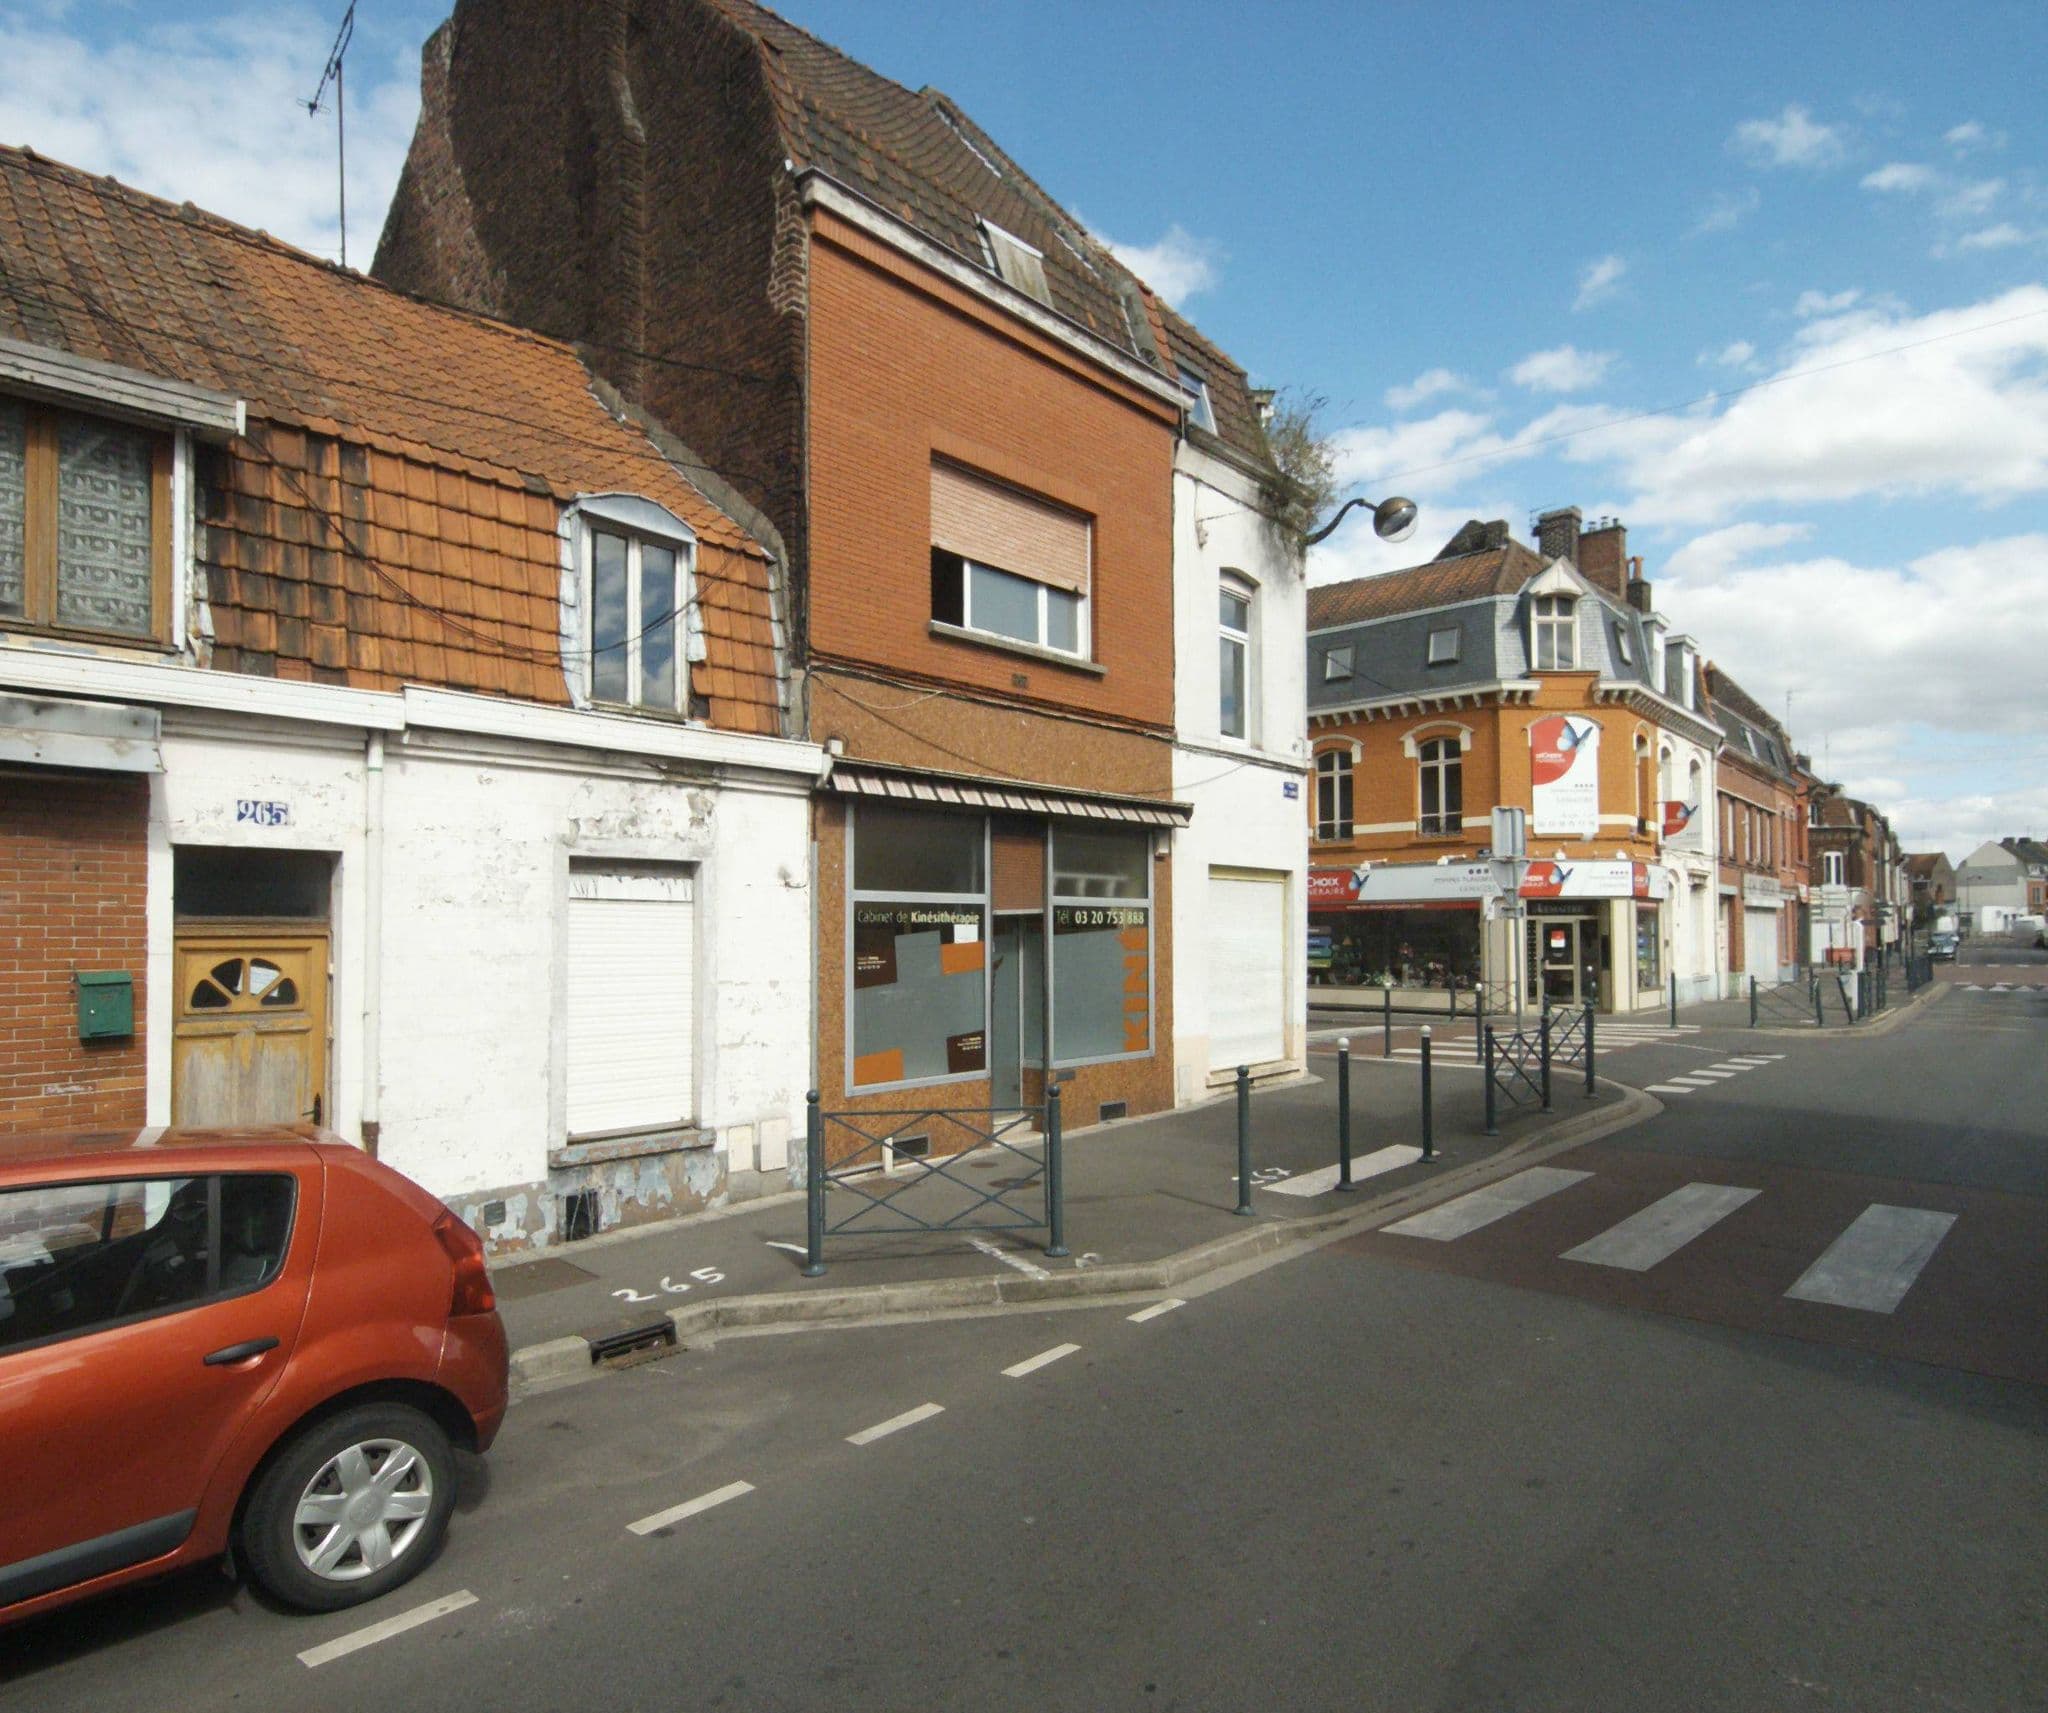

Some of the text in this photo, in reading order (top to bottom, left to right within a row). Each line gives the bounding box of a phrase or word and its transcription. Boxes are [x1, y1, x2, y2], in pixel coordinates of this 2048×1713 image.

[237, 800, 288, 826] 265
[858, 910, 980, 925] Cabinet de Kinésithérapie
[1074, 910, 1088, 925] 03
[1091, 910, 1104, 925] 20
[1106, 911, 1124, 925] 753
[611, 1266, 725, 1302] 265
